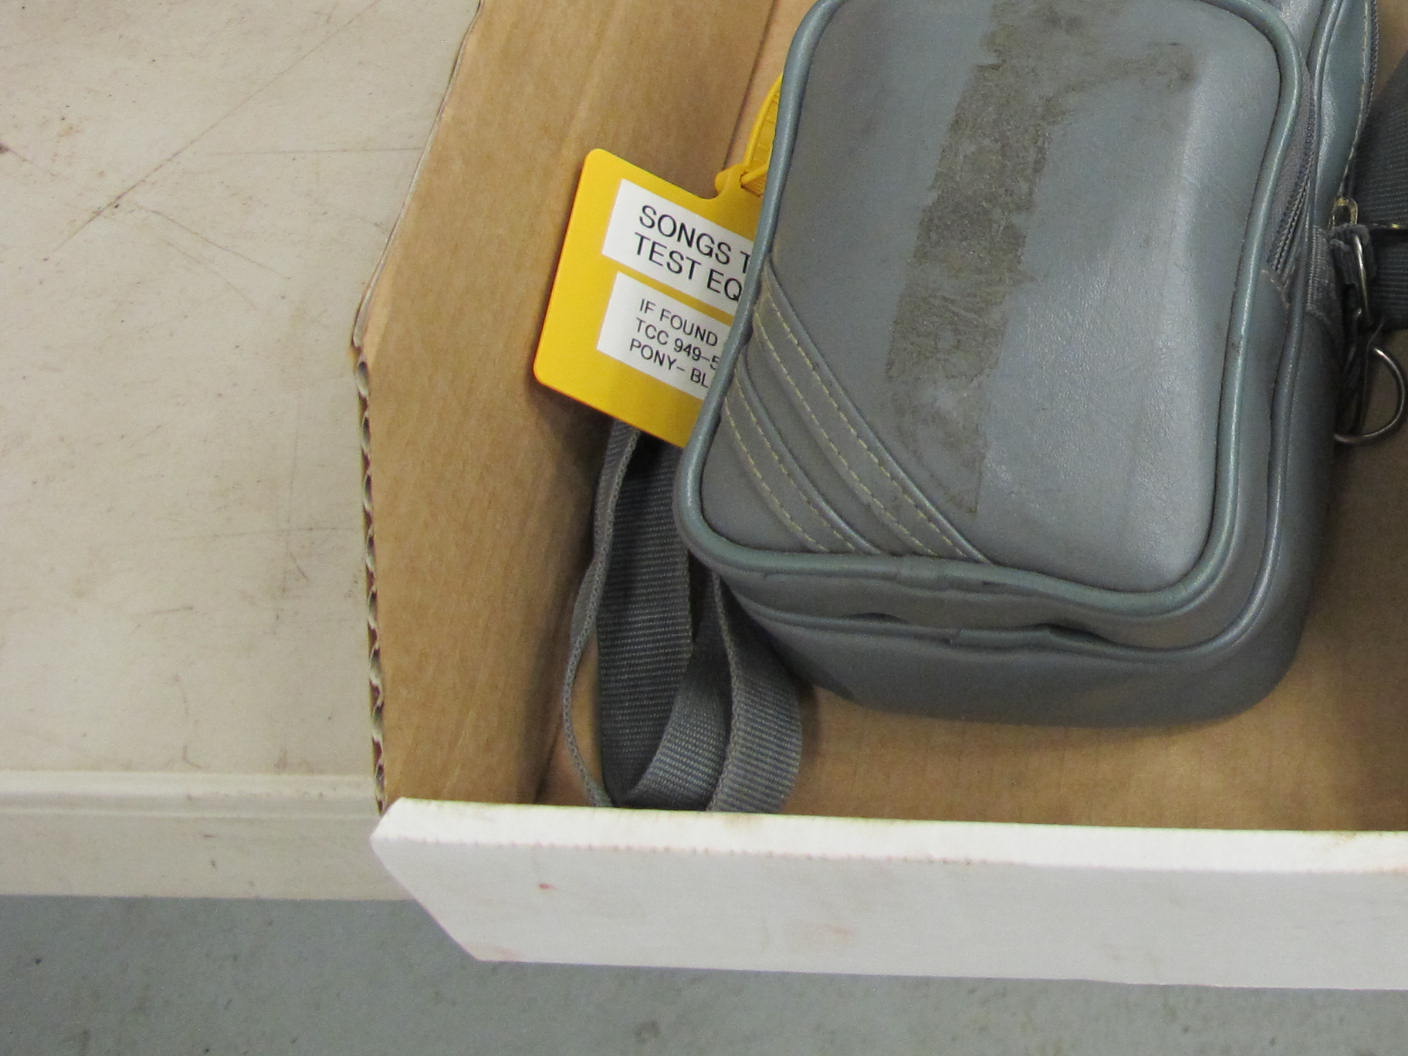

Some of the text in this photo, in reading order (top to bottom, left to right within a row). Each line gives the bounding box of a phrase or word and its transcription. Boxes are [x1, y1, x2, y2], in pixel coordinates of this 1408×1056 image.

[634, 232, 702, 281] TEST
[639, 205, 731, 265] SONGS
[636, 317, 669, 345] TCC
[640, 299, 718, 347] IF FOUND
